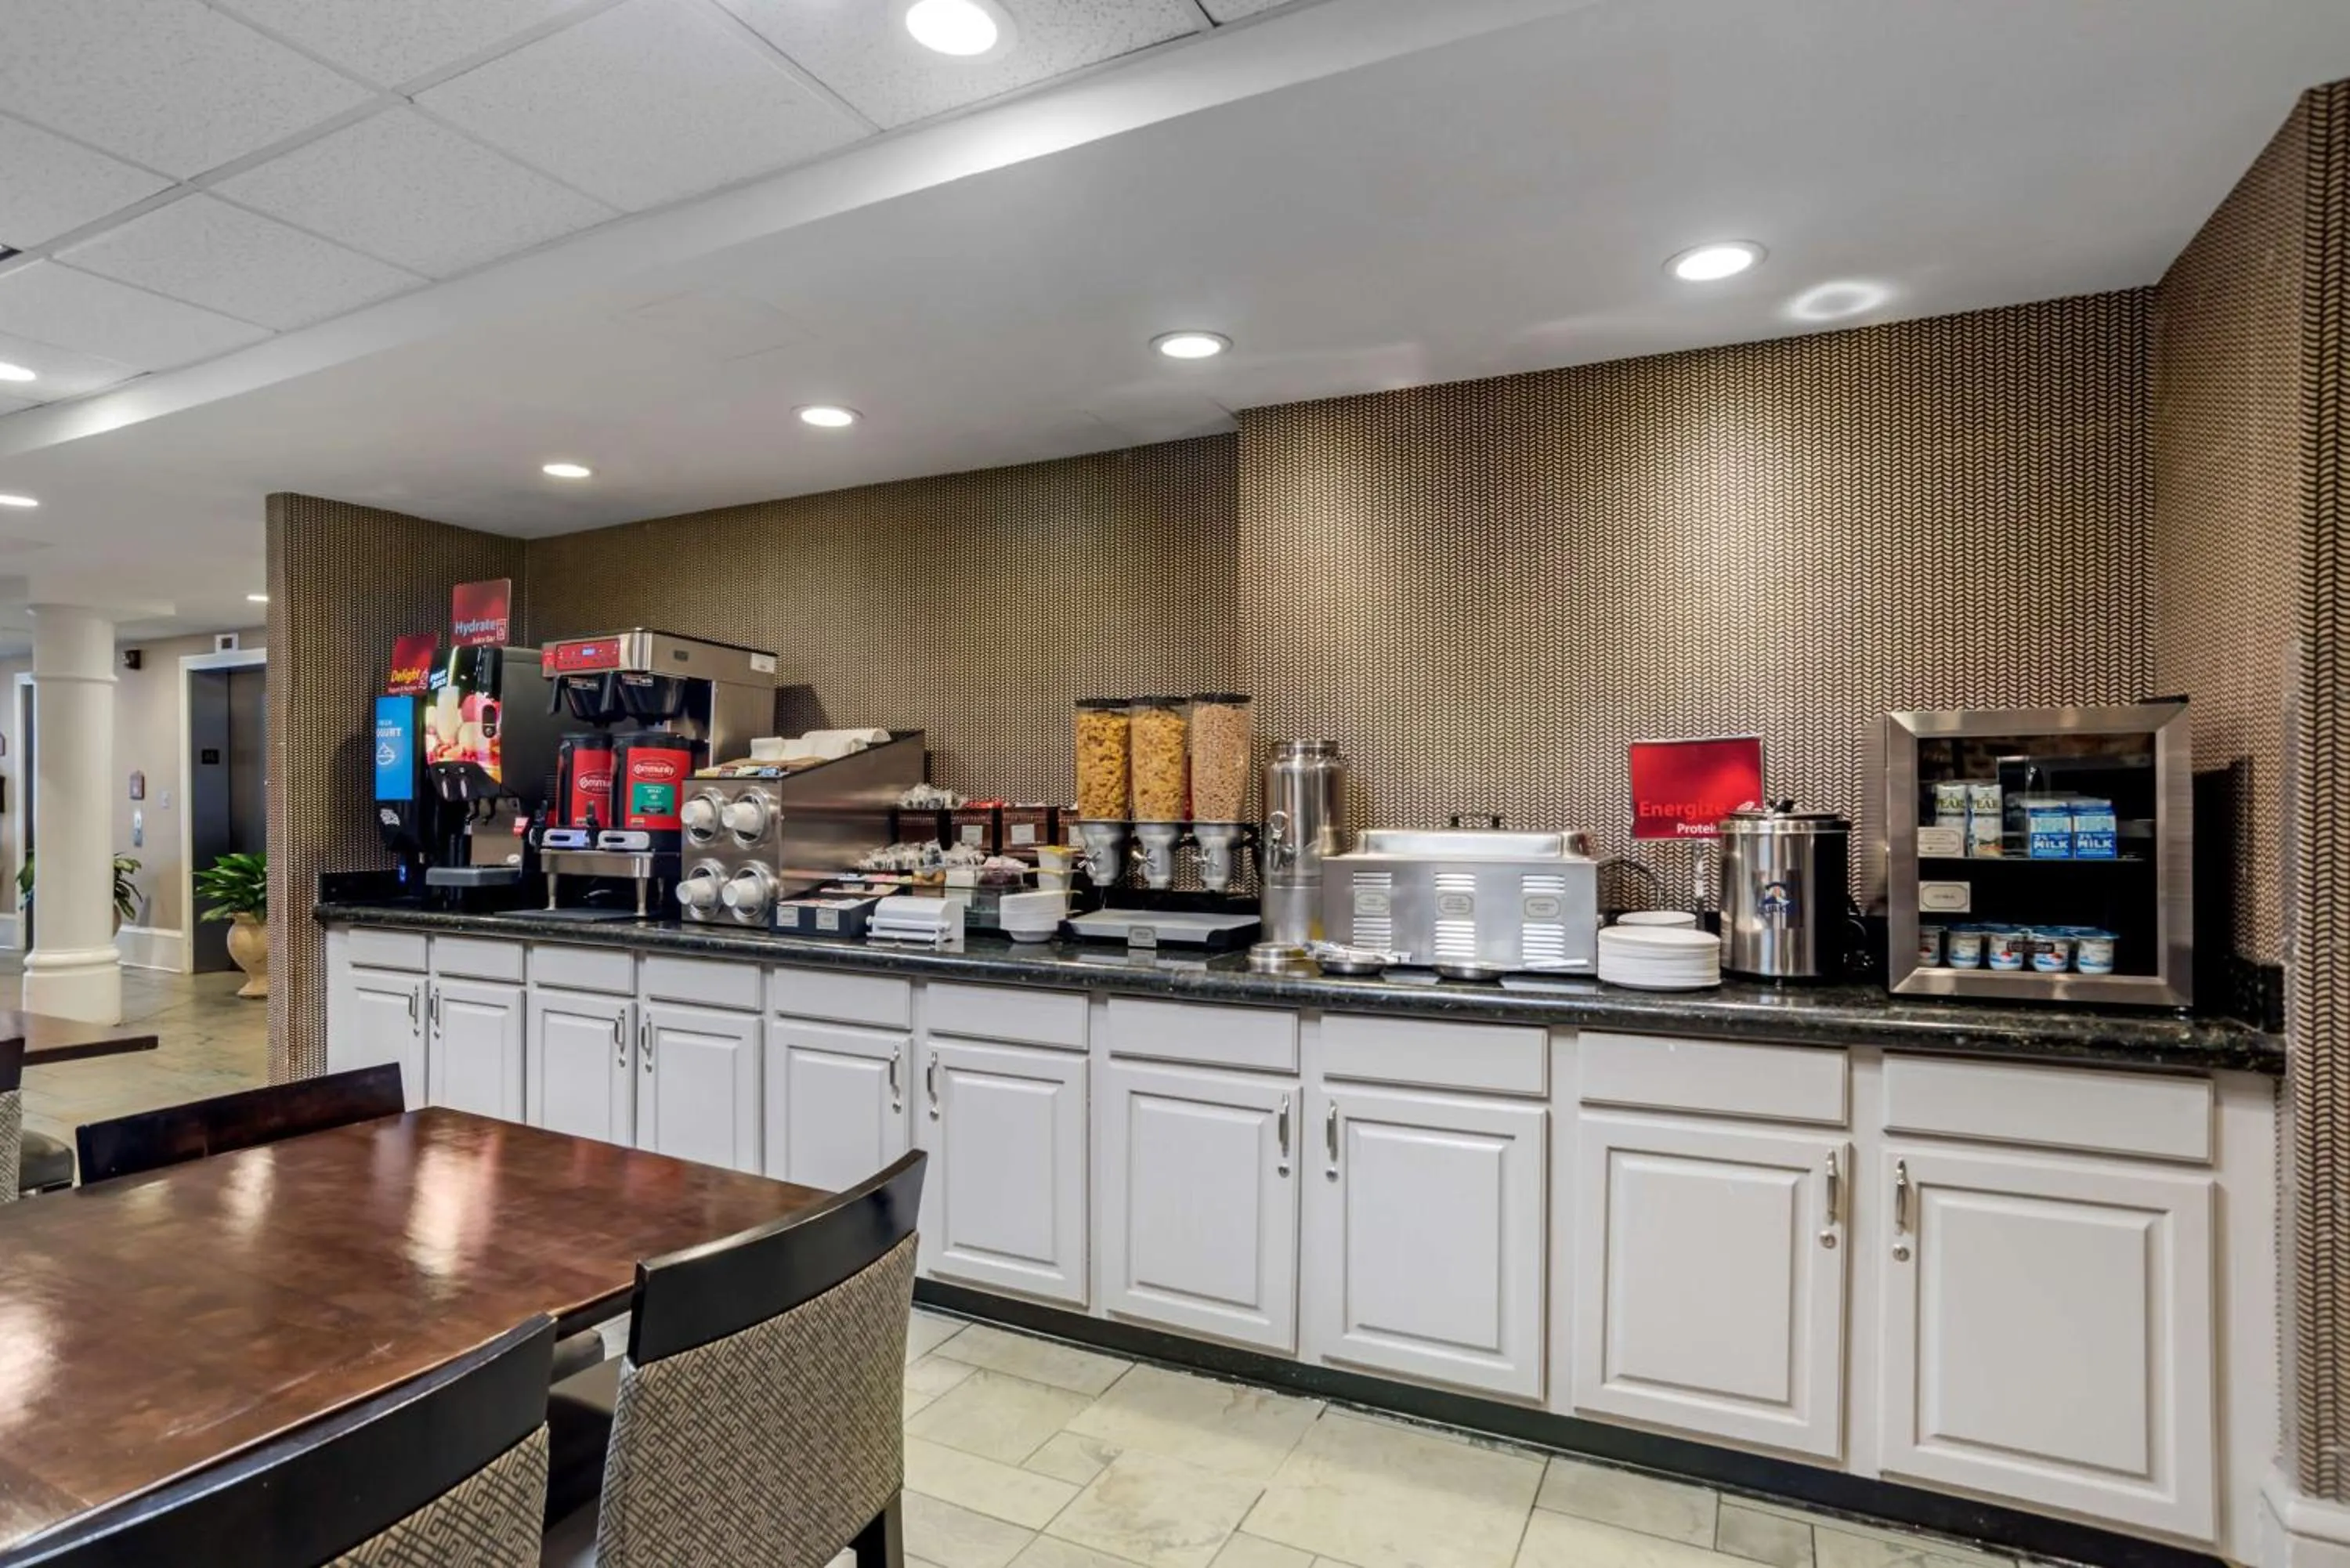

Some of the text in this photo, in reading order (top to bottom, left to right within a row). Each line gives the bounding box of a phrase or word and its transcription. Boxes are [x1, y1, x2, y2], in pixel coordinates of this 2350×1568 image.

[454, 618, 497, 637] Hydrate
[391, 667, 421, 685] Delight
[633, 762, 674, 775] Community
[1638, 800, 1728, 821] Energize
